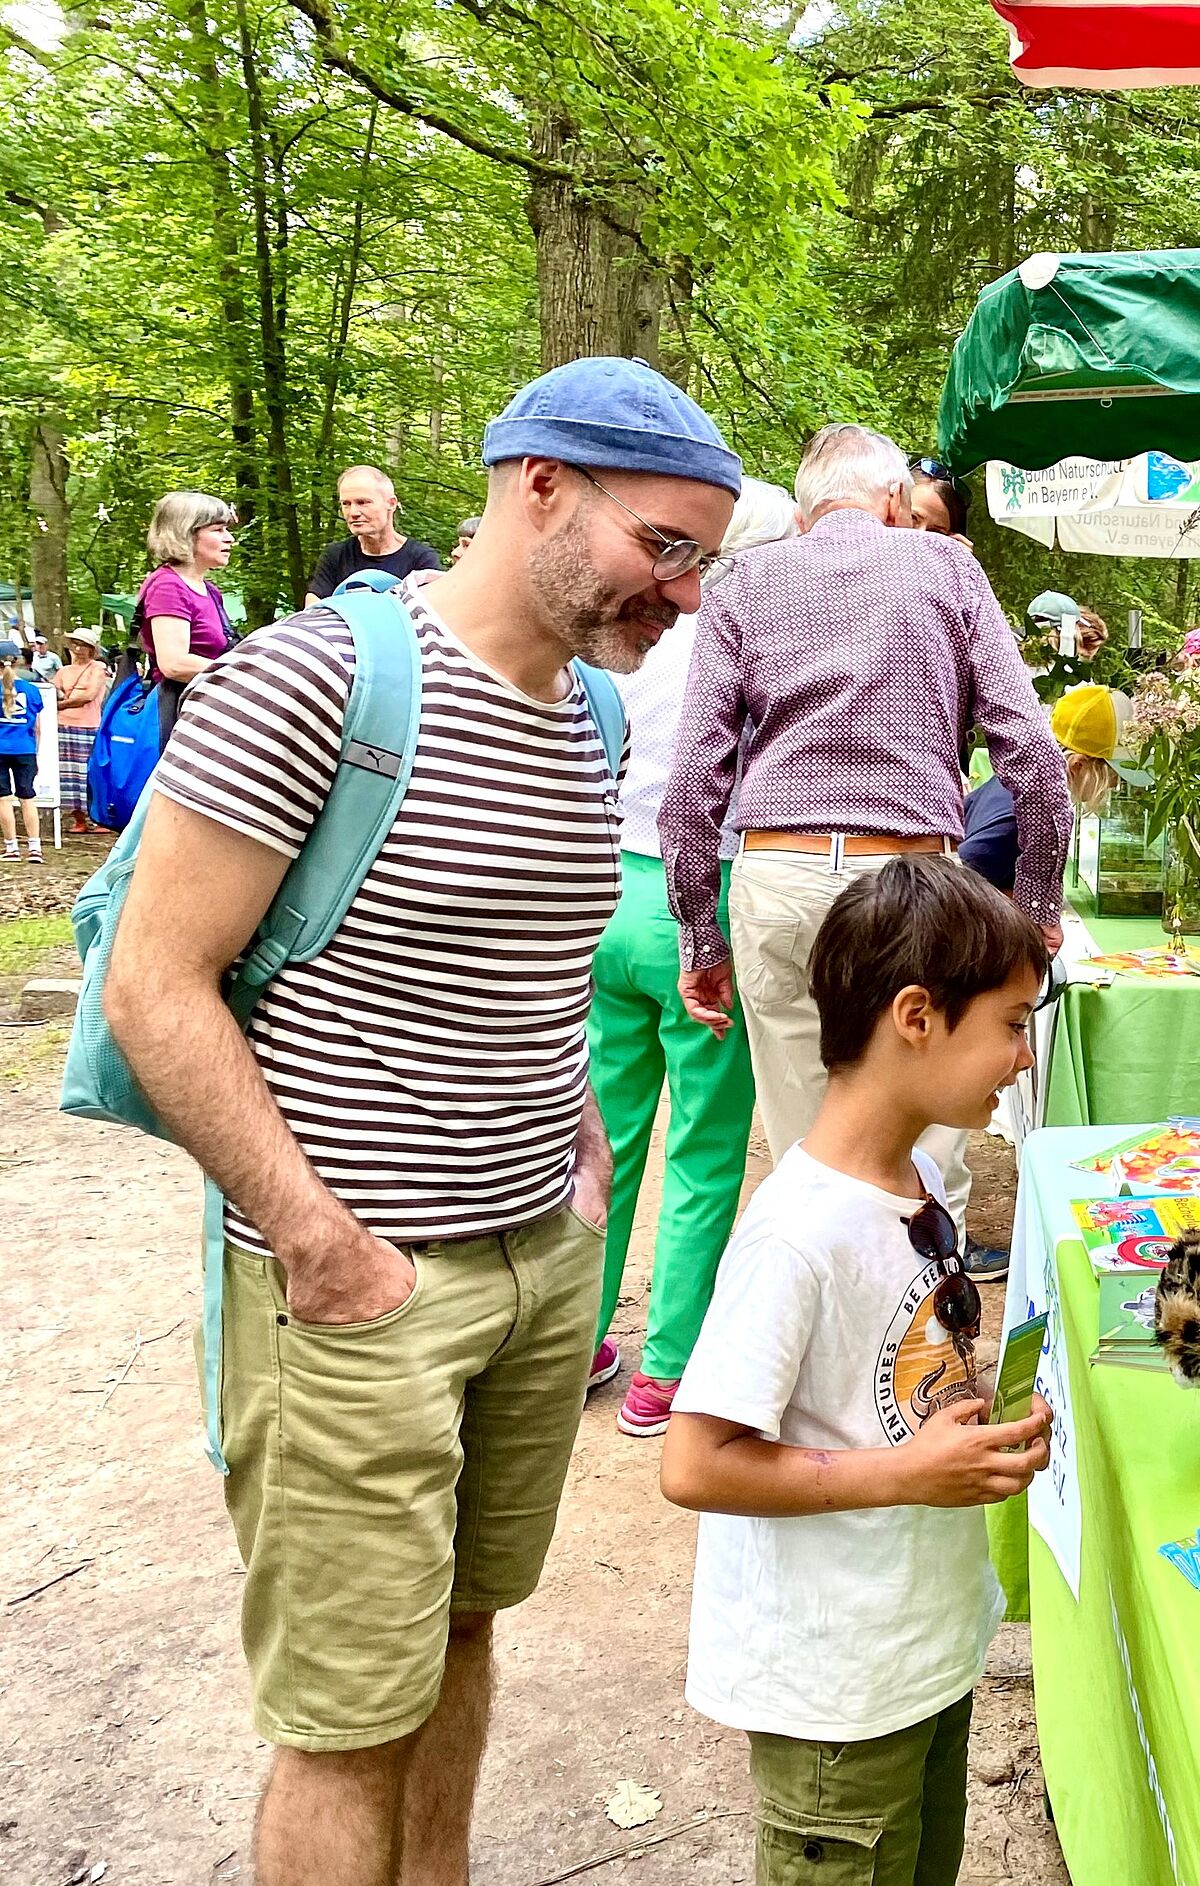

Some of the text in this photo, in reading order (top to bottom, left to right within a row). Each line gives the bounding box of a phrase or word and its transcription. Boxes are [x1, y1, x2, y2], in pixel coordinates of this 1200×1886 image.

[1027, 487, 1039, 504] in
[1041, 486, 1079, 507] Bayern
[903, 1288, 921, 1315] BE
[879, 1342, 907, 1442] ENTURES
